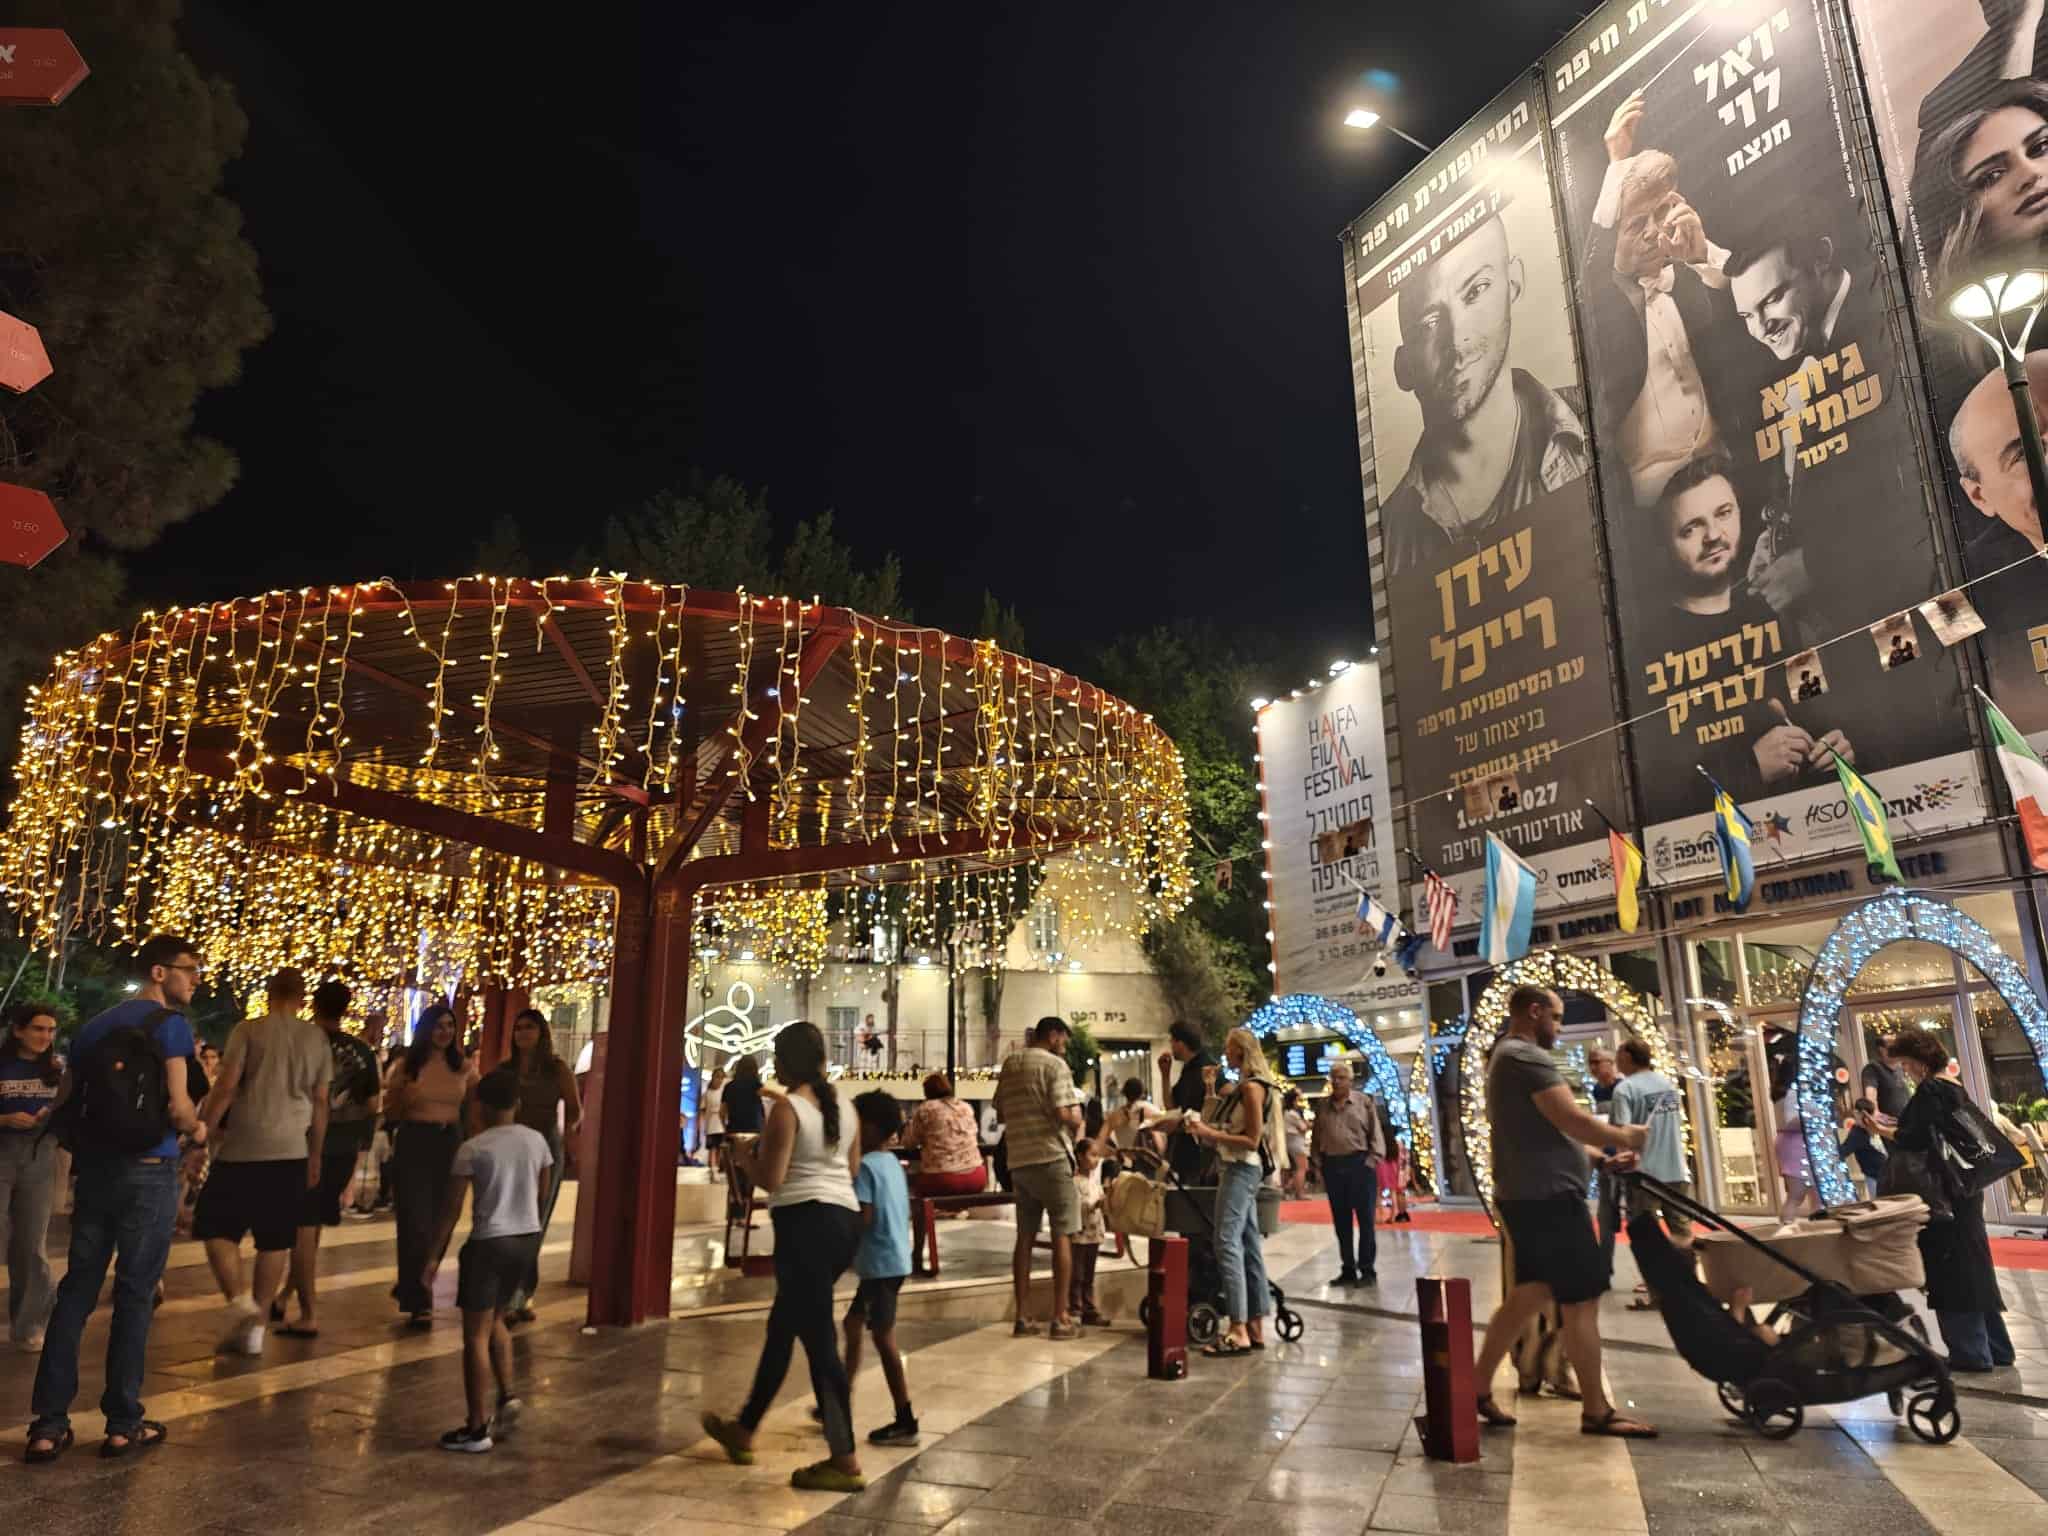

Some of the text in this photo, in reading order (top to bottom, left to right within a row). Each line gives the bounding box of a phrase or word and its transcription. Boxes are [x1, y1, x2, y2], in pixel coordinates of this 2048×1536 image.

[1555, 23, 1620, 93] חיפה
[1693, 7, 1791, 103] יואל
[1717, 67, 1781, 128] לוי
[1414, 101, 1528, 213] הסימפונית
[1726, 118, 1792, 177] מנצח
[1361, 203, 1409, 257] חיפה
[1755, 373, 1882, 463] שמידט
[1434, 527, 1532, 633] עידן
[1429, 596, 1557, 691] רייכל
[1645, 620, 1782, 695] ולדיסלב
[1309, 704, 1358, 744] HAIFA
[1416, 656, 1585, 737] עם הסימפונית חיפה
[1666, 664, 1766, 736] לבריק
[1455, 708, 1546, 756] בניצוחו של
[1696, 715, 1745, 744] מנצח
[1304, 755, 1373, 801] FESTIVAL
[1805, 800, 1849, 827] HSO
[1441, 837, 1483, 865] חיפה
[1557, 864, 1599, 889] אתוס
[1673, 840, 1715, 861] חיפה
[1104, 1010, 1128, 1023] בית
